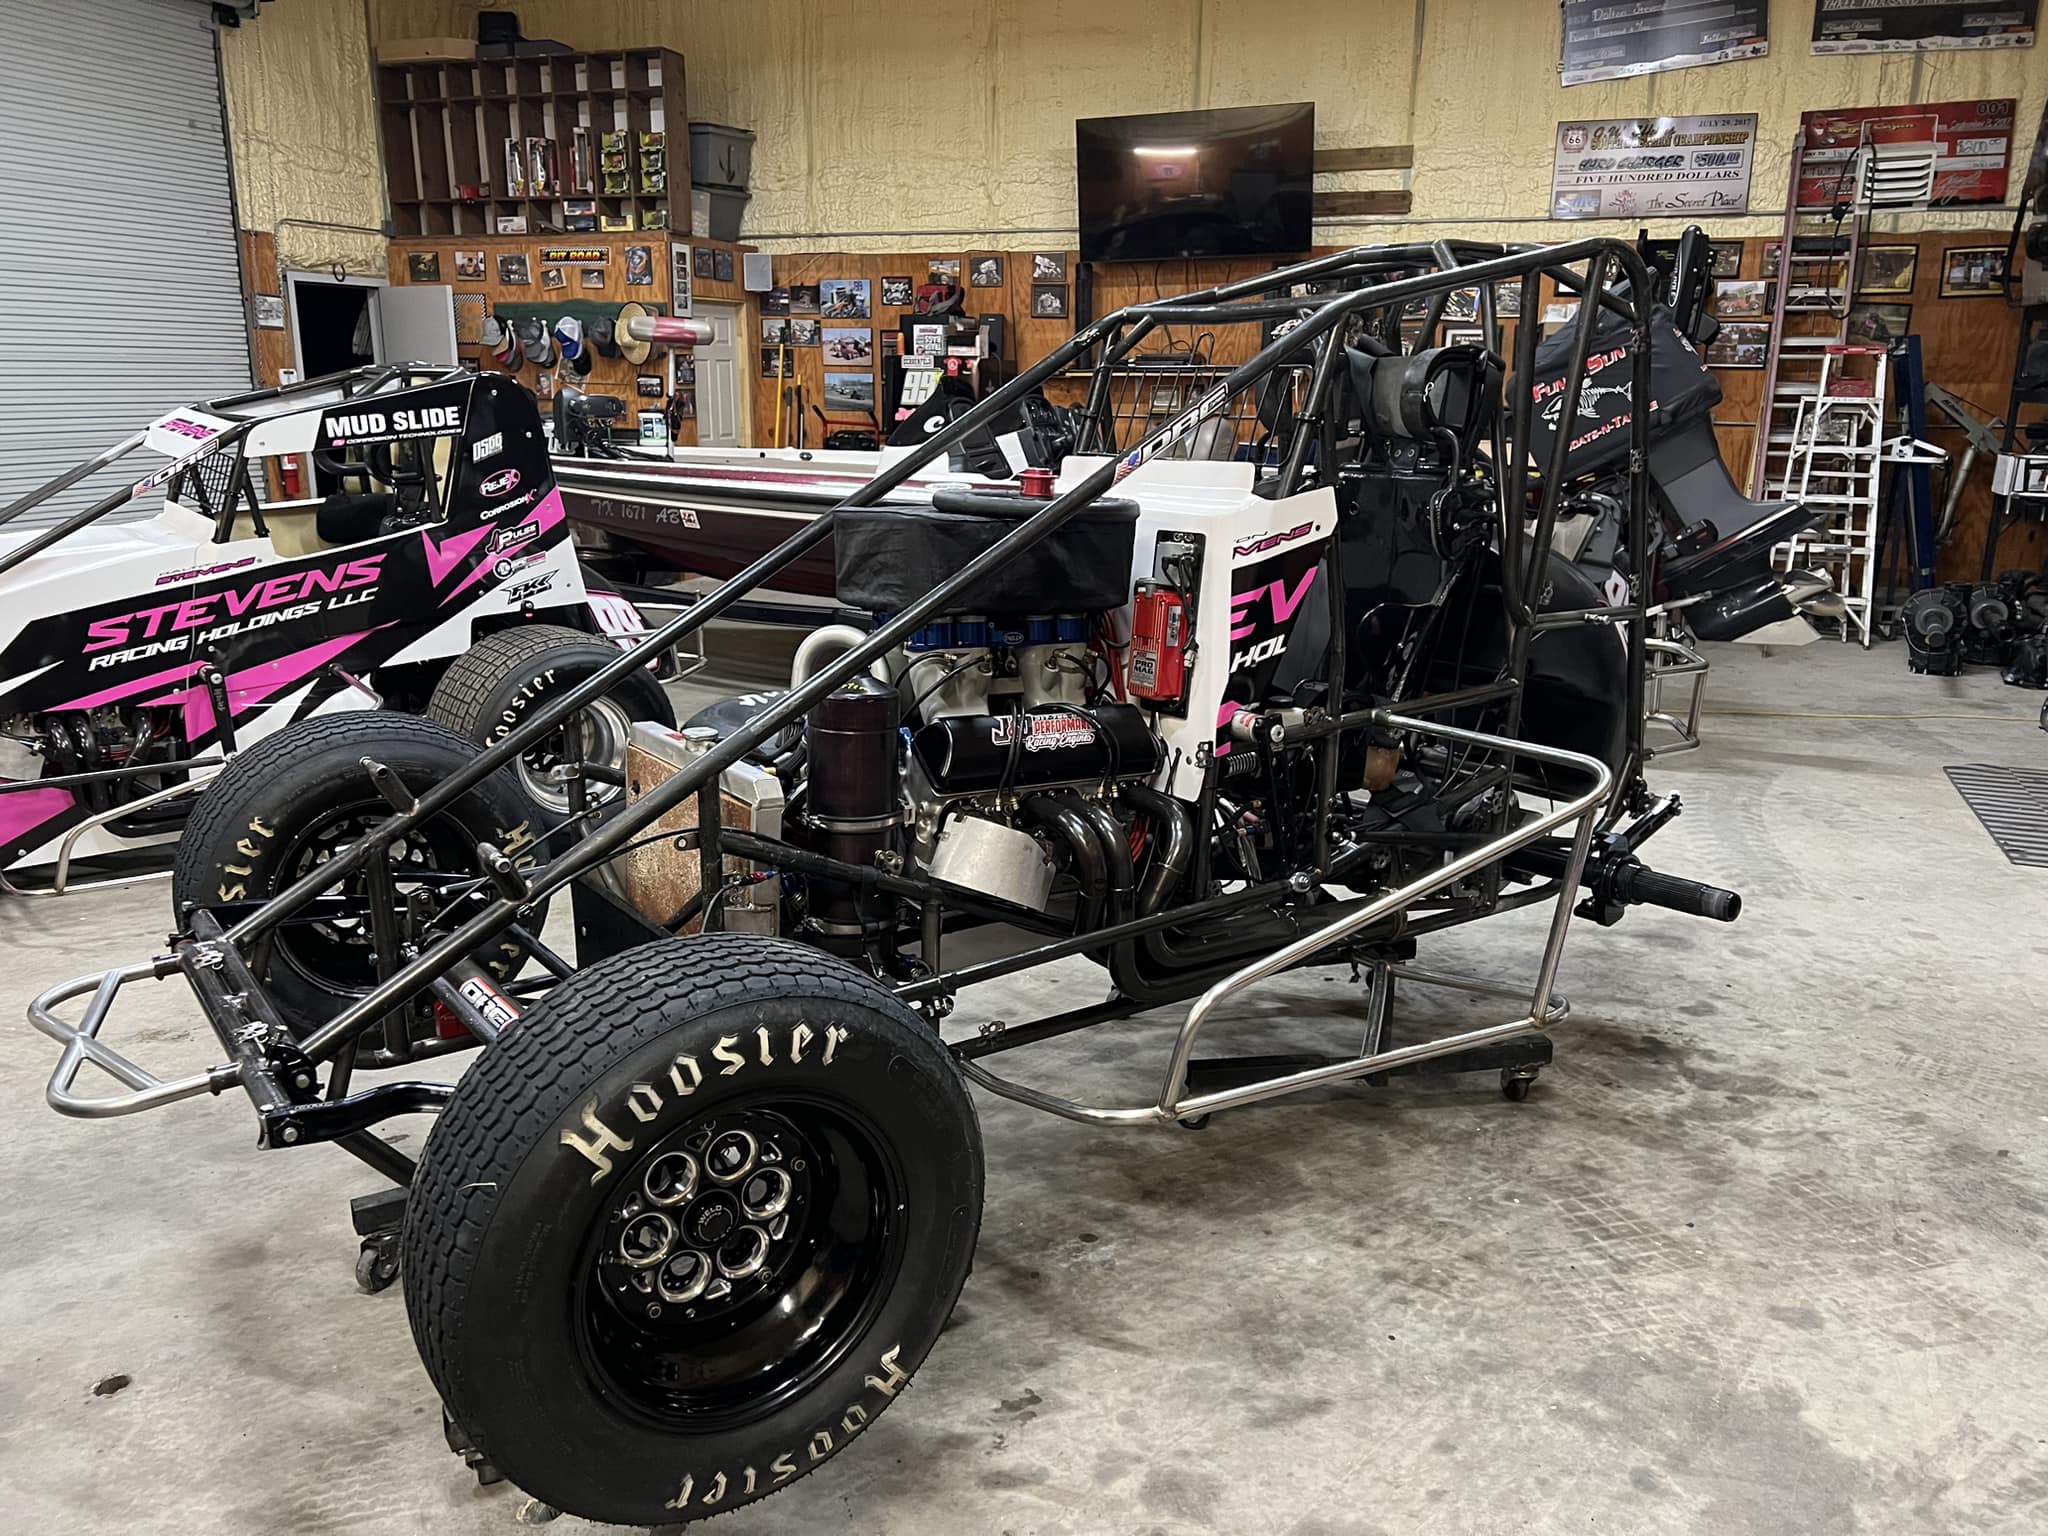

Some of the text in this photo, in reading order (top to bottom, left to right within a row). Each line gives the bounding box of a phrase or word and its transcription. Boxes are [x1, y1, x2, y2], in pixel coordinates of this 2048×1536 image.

[1977, 102, 2009, 115] 001
[1568, 135, 1582, 144] 66
[1576, 170, 1740, 184] FIVE HUNDRED DOLLARS
[549, 252, 601, 260] PIT ROAD
[1533, 346, 1627, 404] FUN SUN
[325, 406, 461, 438] MUD SLIDE
[346, 434, 397, 445] CORROSION
[398, 428, 462, 439] TECHNOLOGIES
[591, 499, 615, 516] TX
[621, 503, 646, 520] 1671
[155, 556, 256, 586] STEVENS
[83, 553, 387, 654] STEVENS
[88, 587, 379, 672] RACING HOLDINGS LLC
[1134, 666, 1154, 675] MAG
[1135, 659, 1154, 669] PRO
[1026, 732, 1096, 752] Racing Engines
[559, 1017, 849, 1186] Hoosier
[697, 1203, 723, 1226] WELD
[664, 1343, 912, 1511] Hoosier
